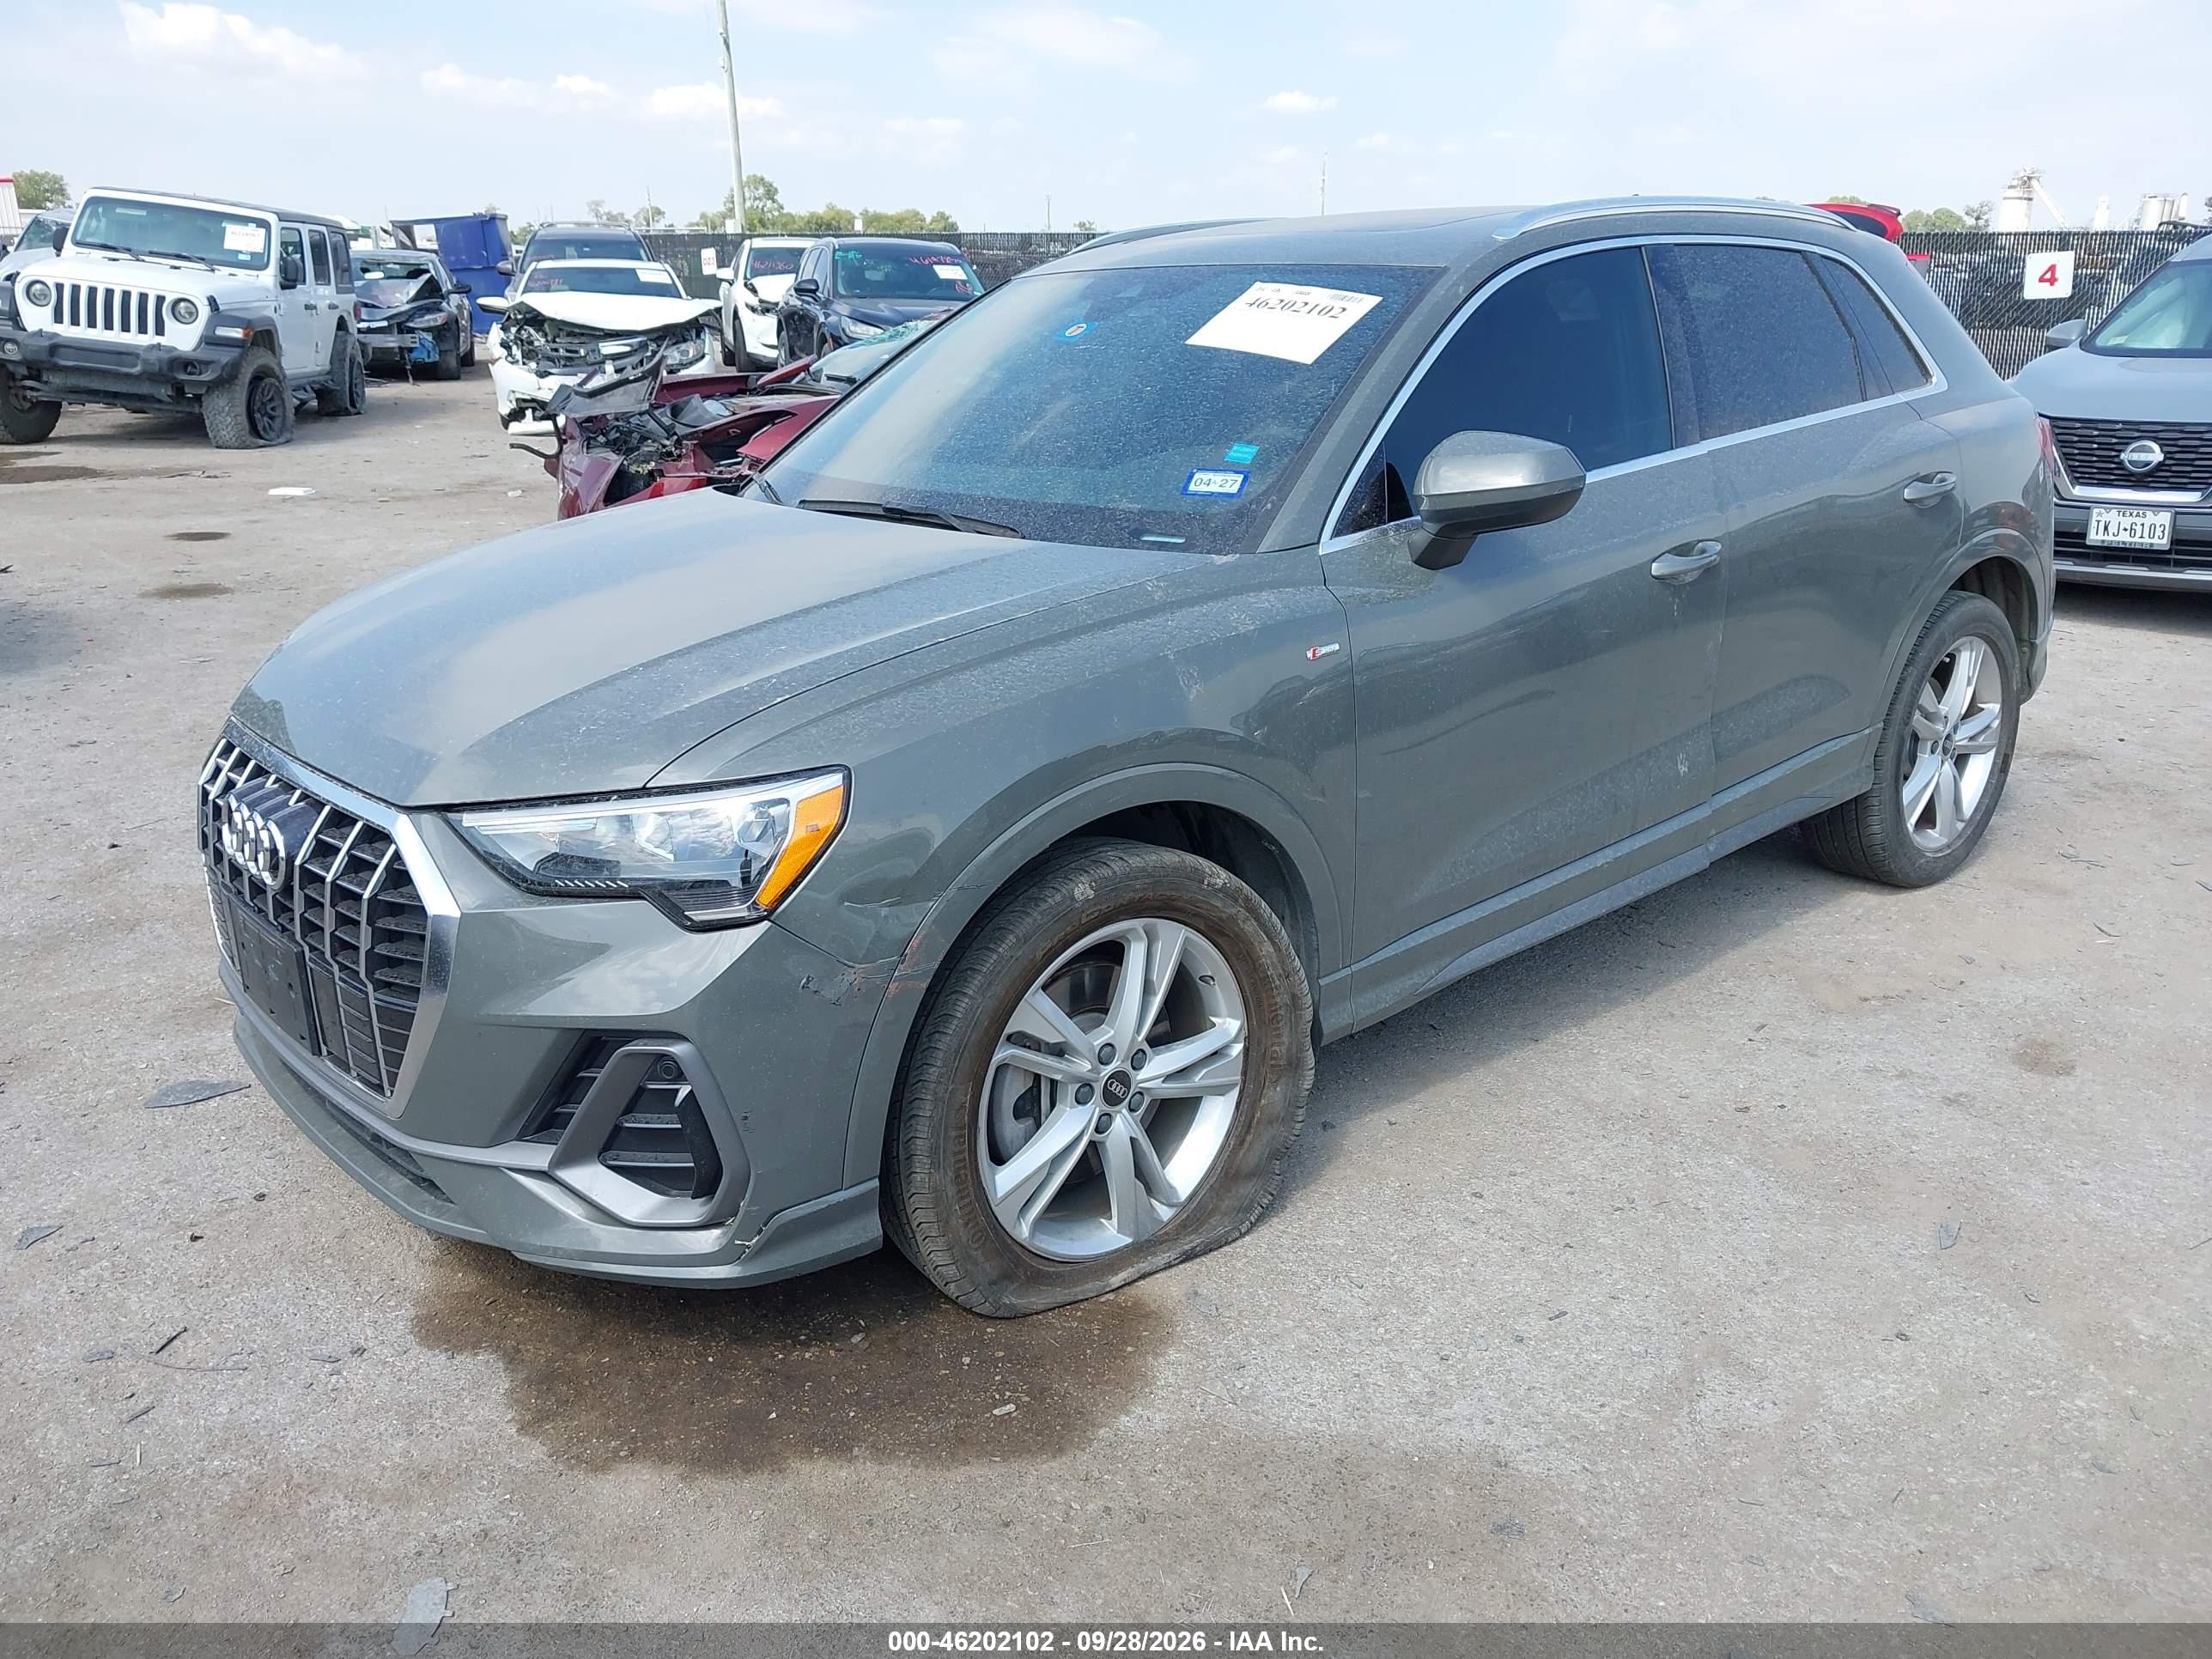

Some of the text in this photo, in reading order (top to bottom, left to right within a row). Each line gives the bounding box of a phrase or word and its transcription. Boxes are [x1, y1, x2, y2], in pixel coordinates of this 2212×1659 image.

[2038, 264, 2058, 286] 4
[1245, 297, 1347, 319] 46202102
[2117, 510, 2147, 519] TEXAS
